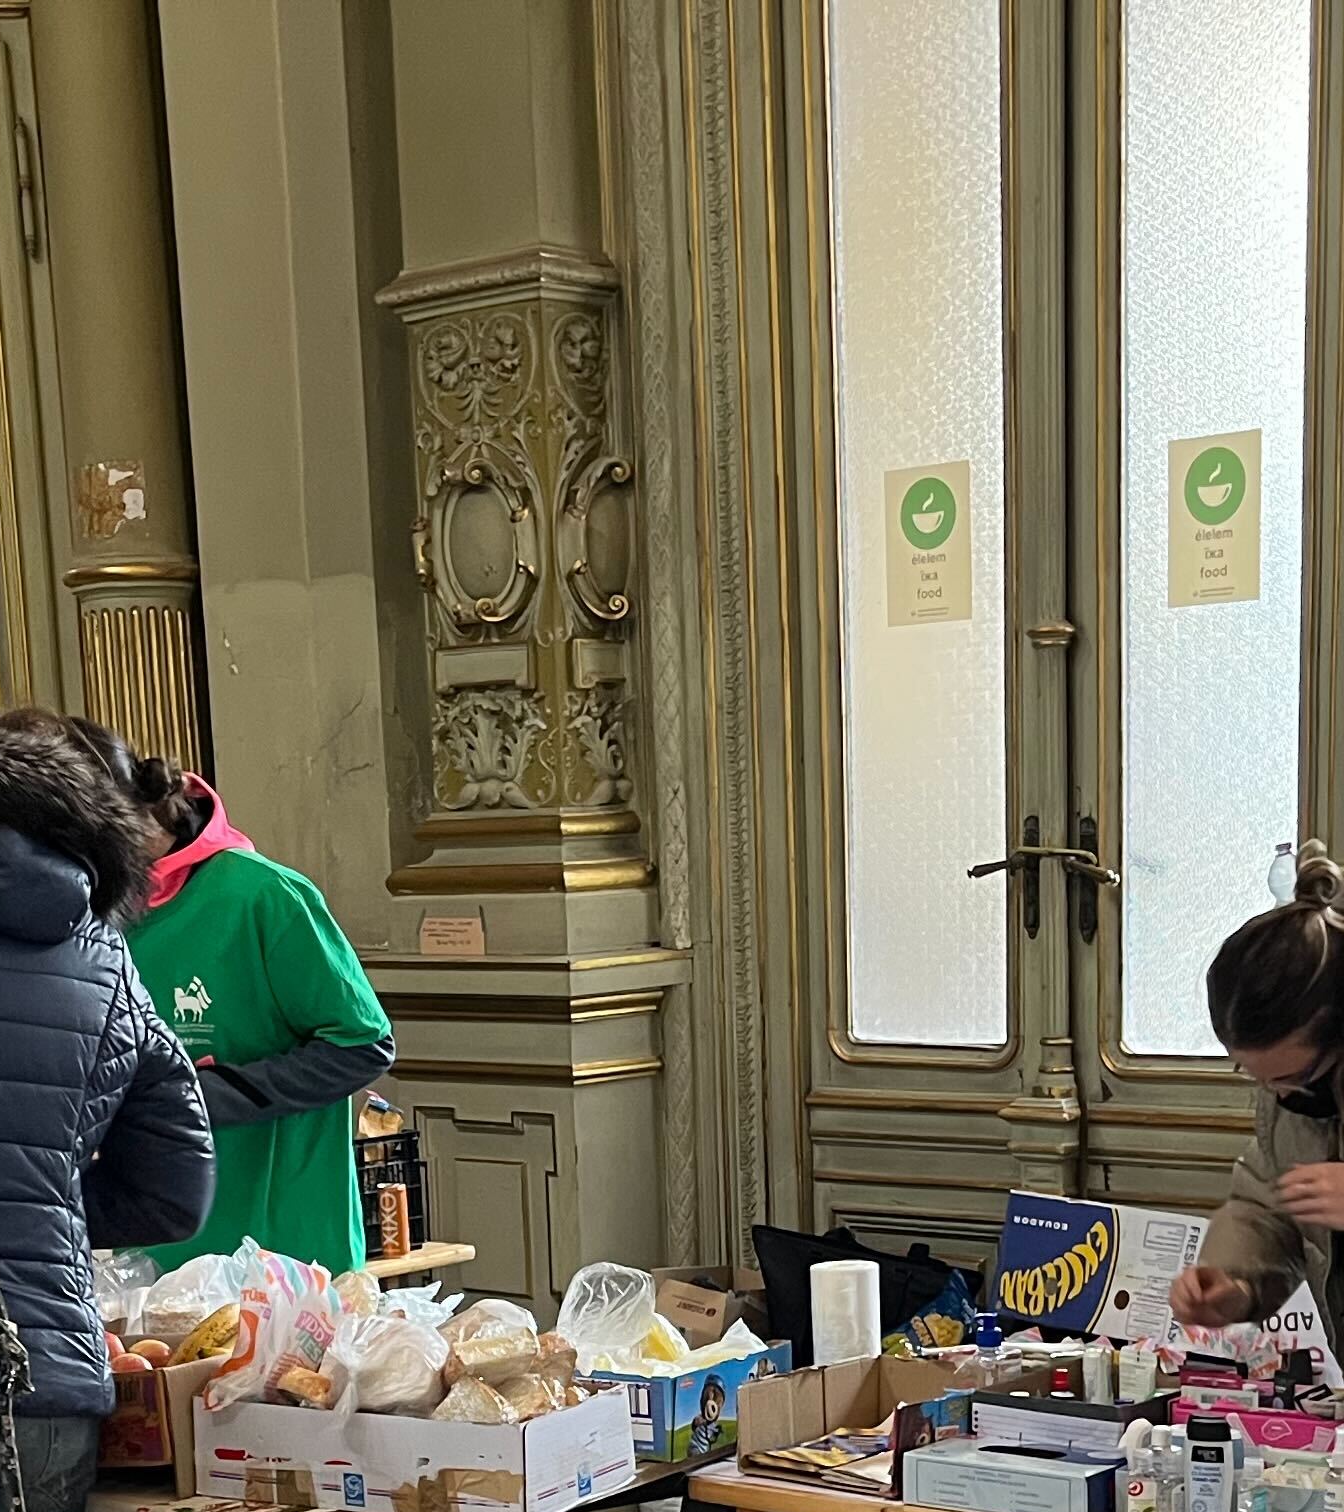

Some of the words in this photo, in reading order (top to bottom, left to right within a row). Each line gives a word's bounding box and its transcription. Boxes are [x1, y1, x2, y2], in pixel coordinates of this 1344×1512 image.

[1195, 528, 1233, 541] élelem
[912, 553, 946, 565] élelem
[1204, 548, 1224, 559] їжа
[1200, 565, 1227, 578] food
[917, 587, 942, 599] food
[1013, 1215, 1068, 1231] ECUADOR
